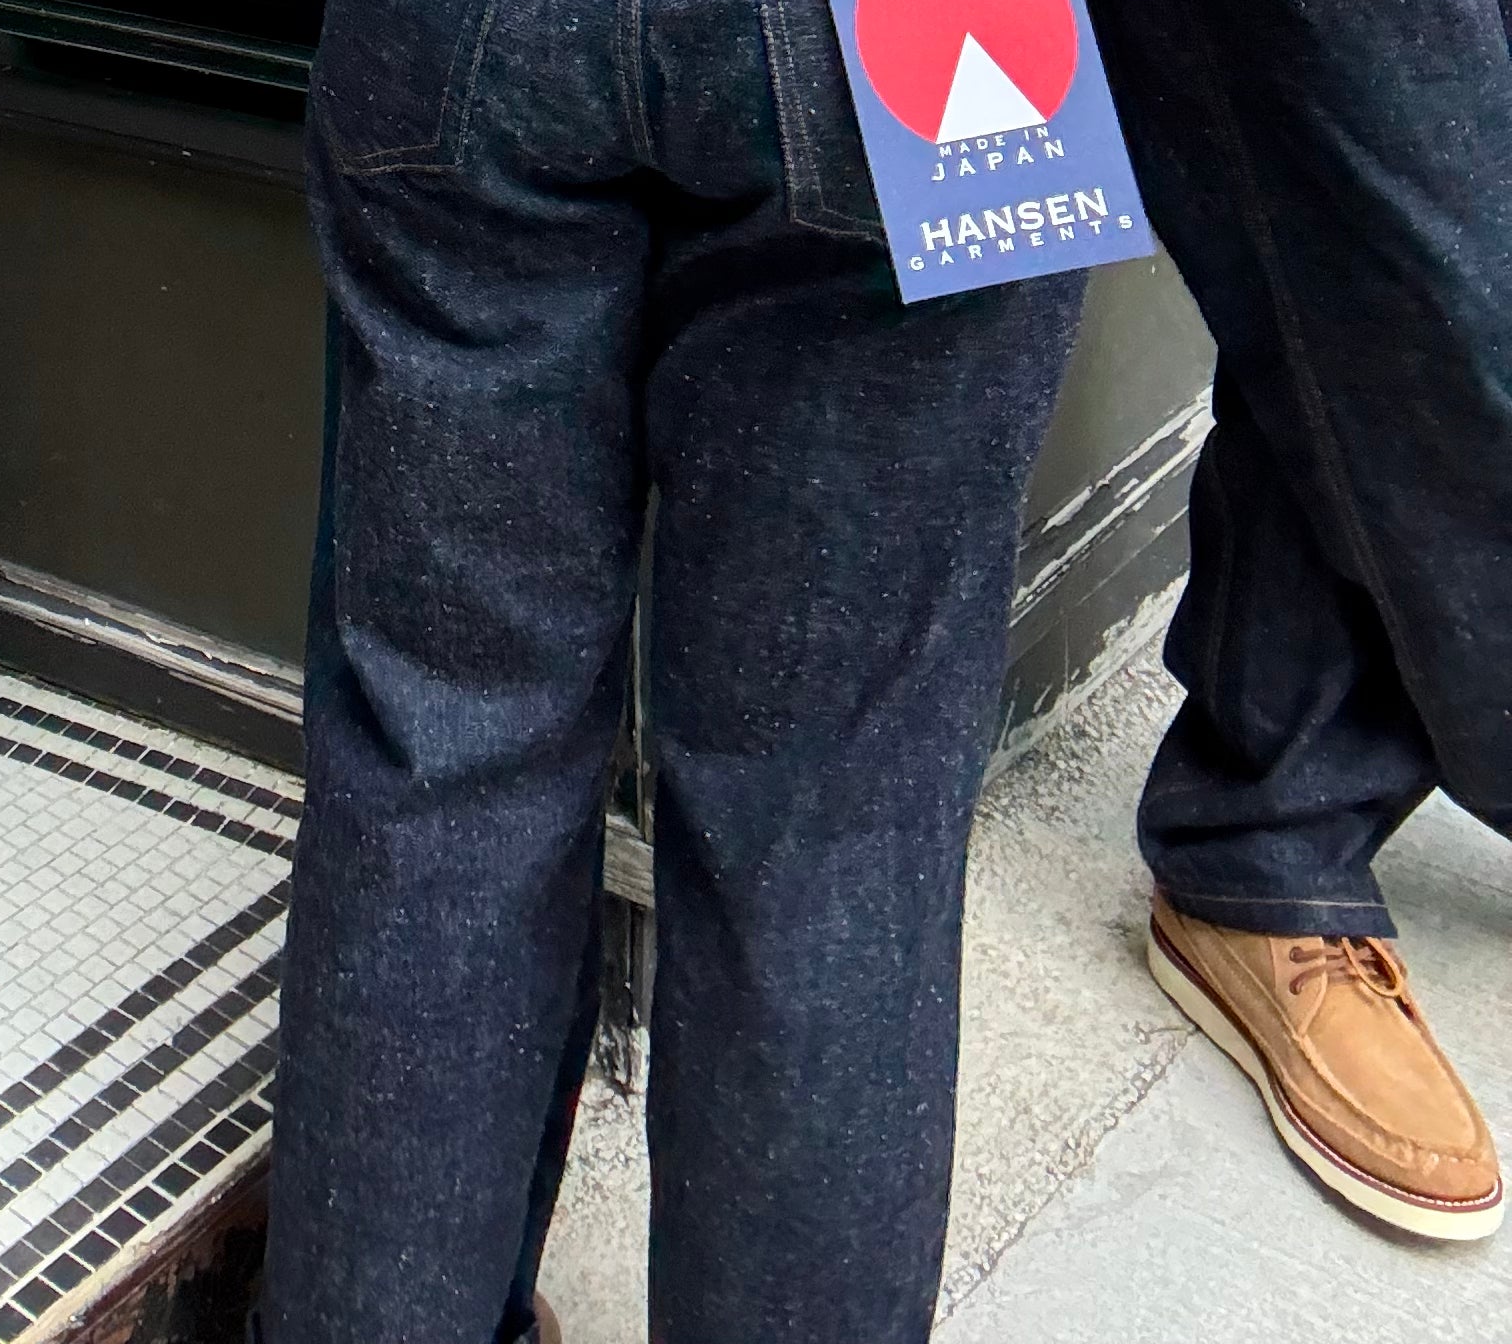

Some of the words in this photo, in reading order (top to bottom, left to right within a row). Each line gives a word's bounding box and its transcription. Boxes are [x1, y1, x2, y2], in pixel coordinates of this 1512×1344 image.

[931, 139, 1065, 181] JAPAN
[939, 134, 1006, 158] MADE
[1024, 125, 1049, 141] IN
[909, 214, 1133, 272] GARMENTS
[920, 187, 1110, 251] HANSEN
